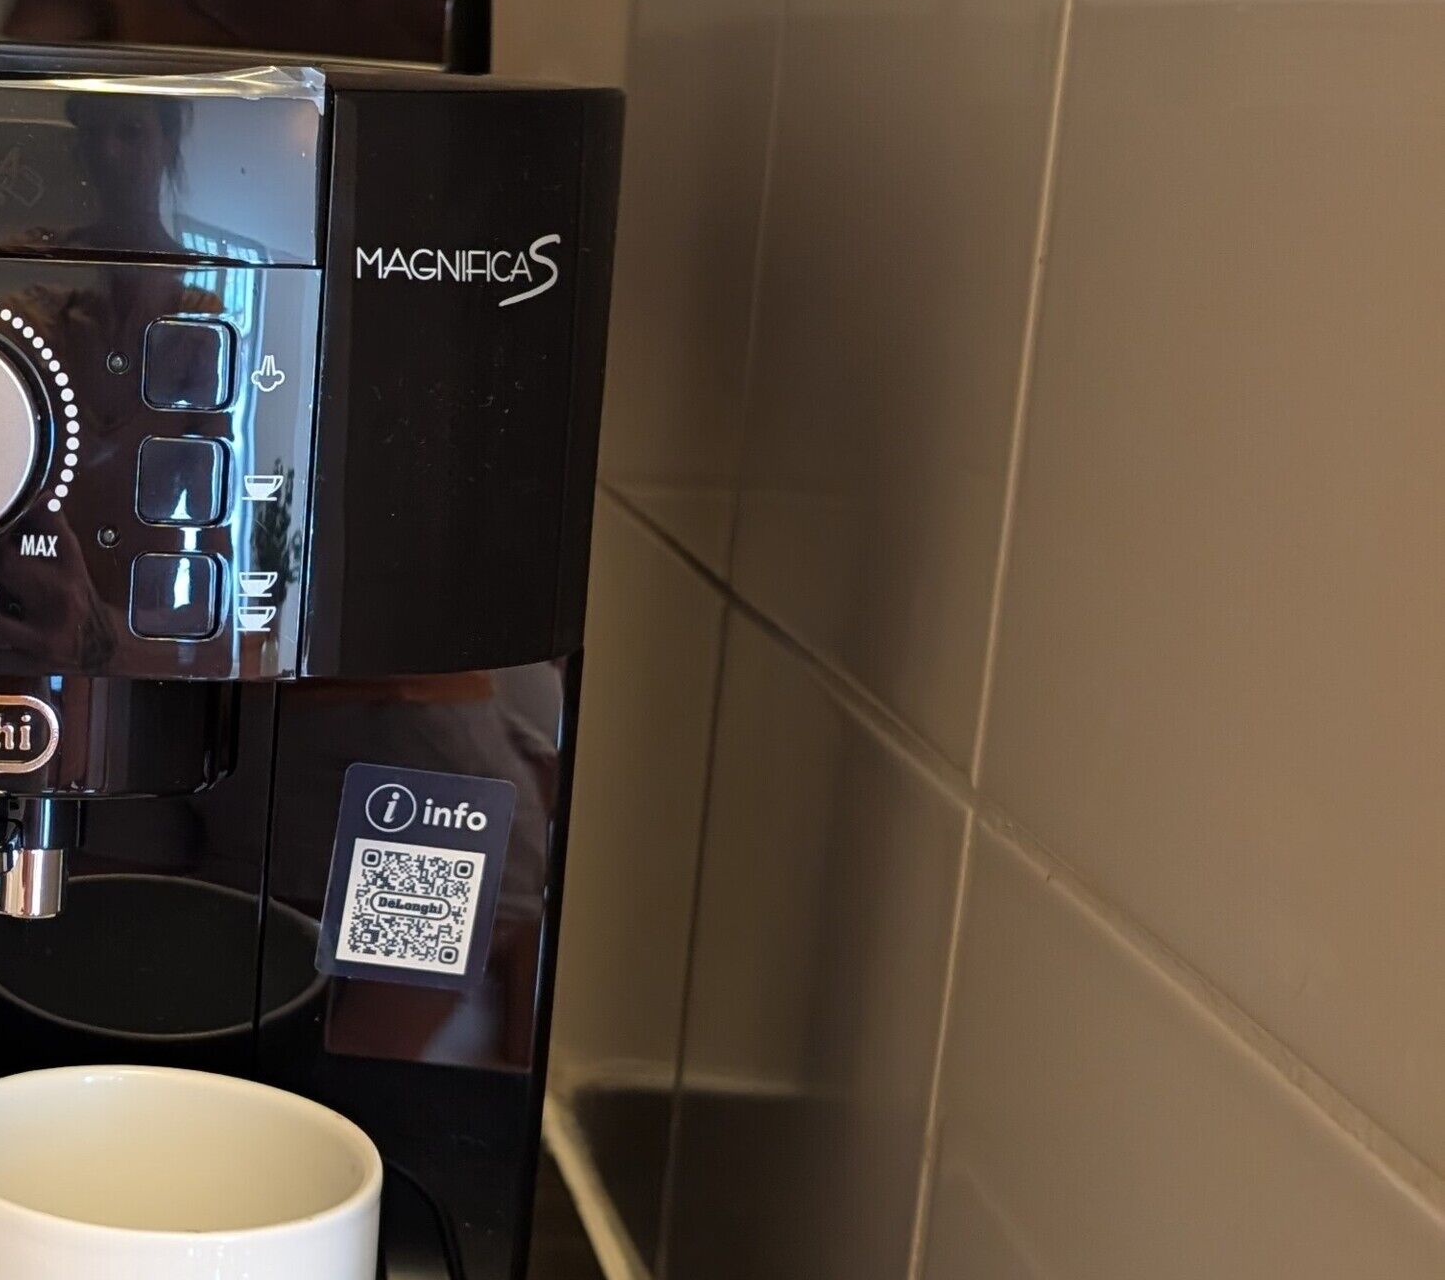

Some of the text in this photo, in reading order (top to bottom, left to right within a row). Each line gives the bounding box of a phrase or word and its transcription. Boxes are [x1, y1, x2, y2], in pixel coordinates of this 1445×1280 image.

[356, 246, 533, 282] MAGNIFICA
[20, 534, 58, 557] MAX
[422, 798, 487, 831] info
